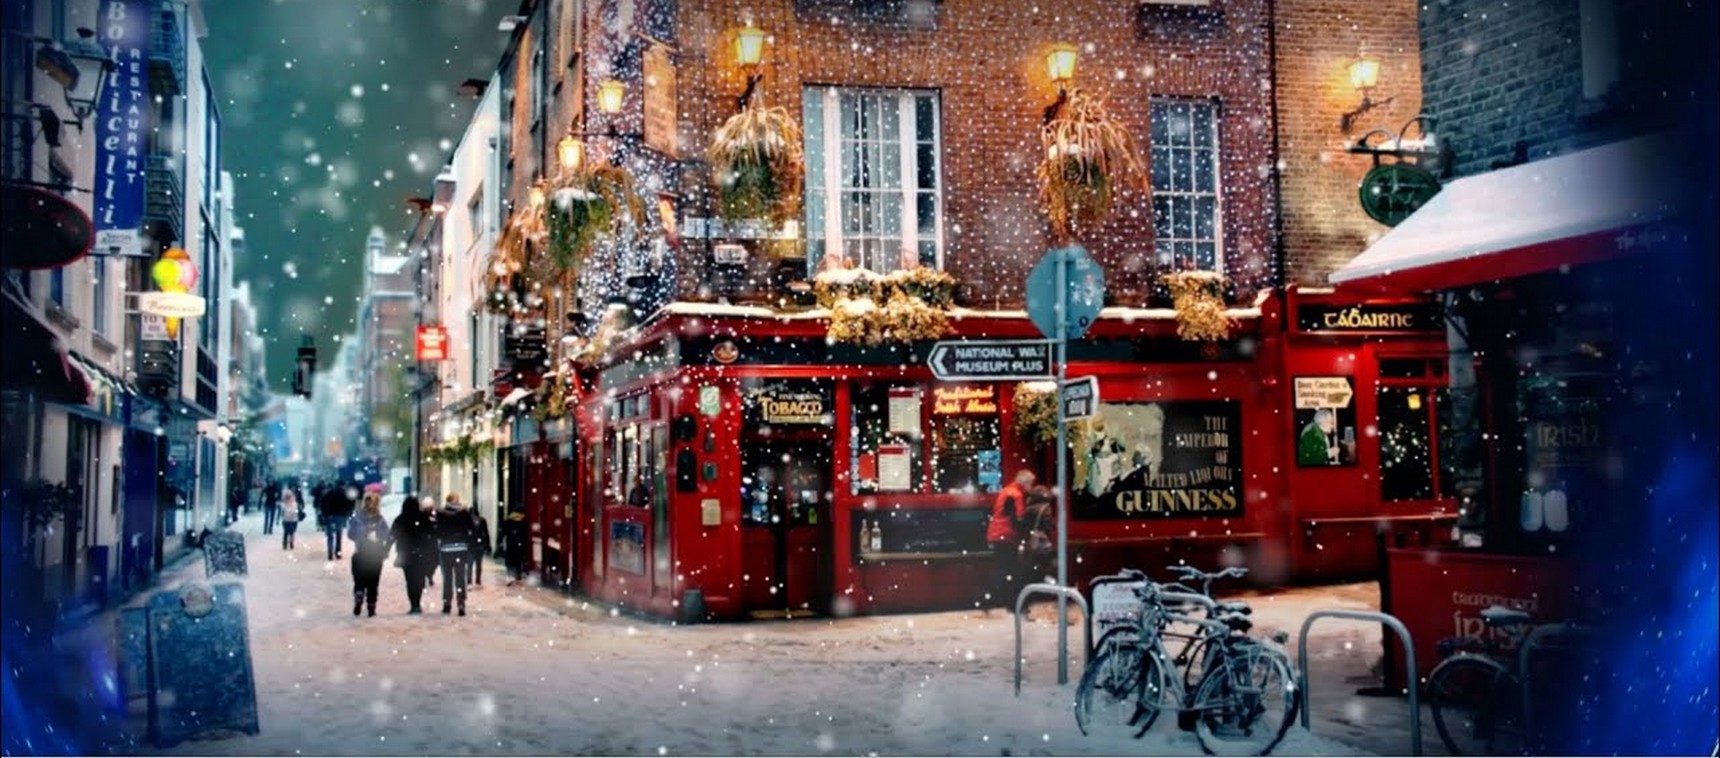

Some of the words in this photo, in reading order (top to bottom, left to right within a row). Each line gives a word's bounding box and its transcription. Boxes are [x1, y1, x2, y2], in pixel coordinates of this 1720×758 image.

[104, 1, 125, 223] Botticelli
[126, 48, 140, 184] RESTAURANT
[955, 346, 1015, 358] NATIONAL
[1019, 346, 1046, 358] WAX
[955, 360, 1009, 372] MUSEUM
[1012, 360, 1044, 372] PLUS
[757, 395, 822, 421] TOBACCO
[965, 399, 997, 413] Music
[1204, 415, 1227, 431] THE
[1176, 432, 1229, 448] EMPEROR
[1115, 489, 1237, 512] GUINNESS
